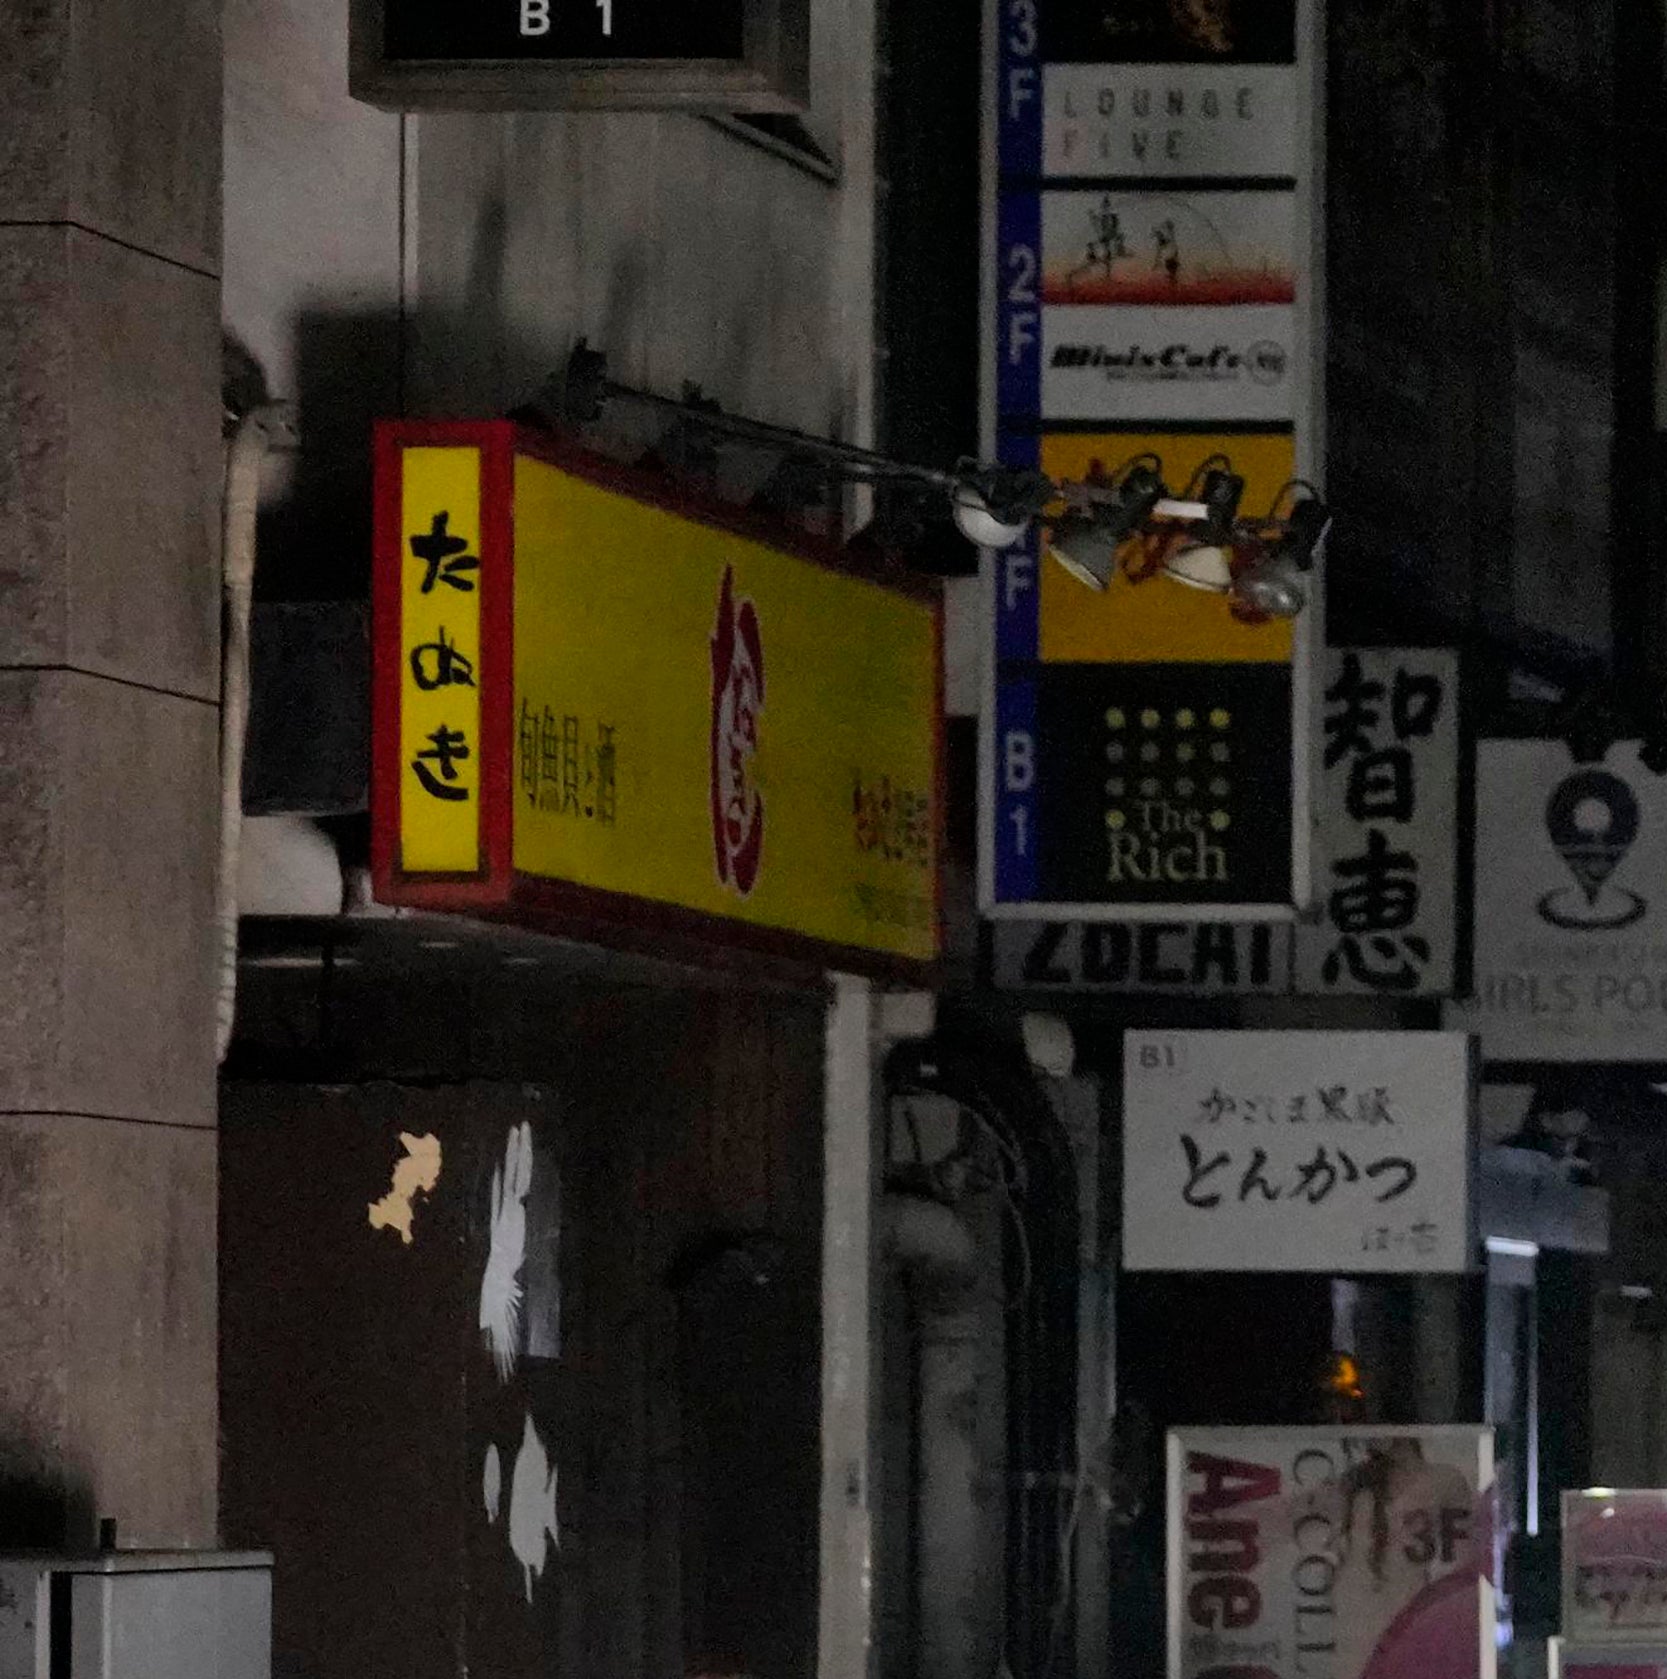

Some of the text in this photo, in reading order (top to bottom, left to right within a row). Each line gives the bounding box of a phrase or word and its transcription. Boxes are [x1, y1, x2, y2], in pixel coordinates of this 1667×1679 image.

[1062, 87, 1253, 121] LOUNGE
[1063, 129, 1183, 160] FIVE
[1007, 243, 1038, 366] 2F
[410, 511, 481, 802] たぬき
[1004, 728, 1036, 857] B1
[1133, 799, 1204, 834] The
[1323, 652, 1443, 991] 智恵
[1107, 831, 1230, 883] Rich
[1138, 1045, 1176, 1069] B1
[1178, 1133, 1419, 1208] とんかつ
[1402, 1507, 1471, 1564] 3F
